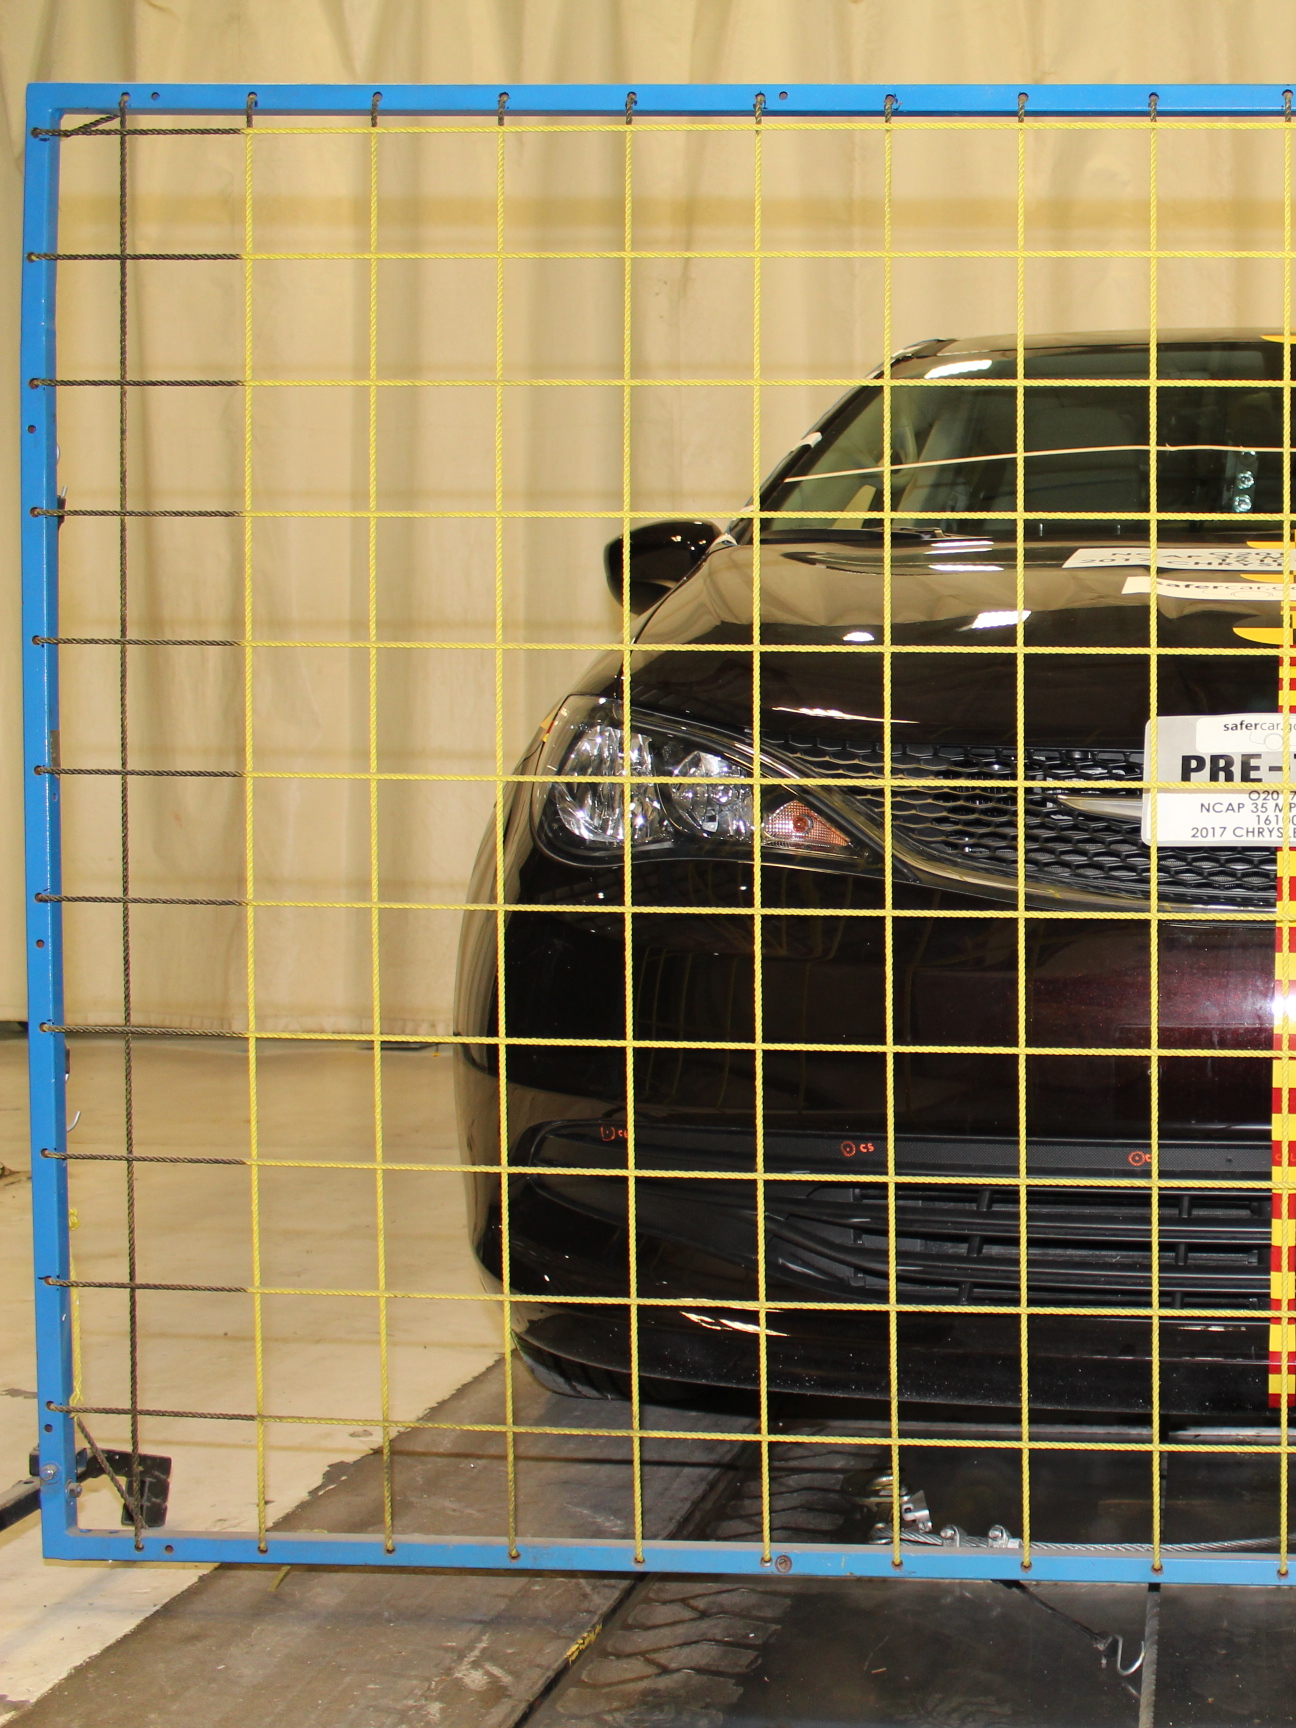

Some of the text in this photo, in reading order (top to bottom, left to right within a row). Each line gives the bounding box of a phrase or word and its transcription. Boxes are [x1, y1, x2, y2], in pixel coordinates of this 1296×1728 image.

[1200, 802, 1245, 814] NCAP
[1250, 802, 1268, 814] 35
[1190, 826, 1227, 839] 2017
